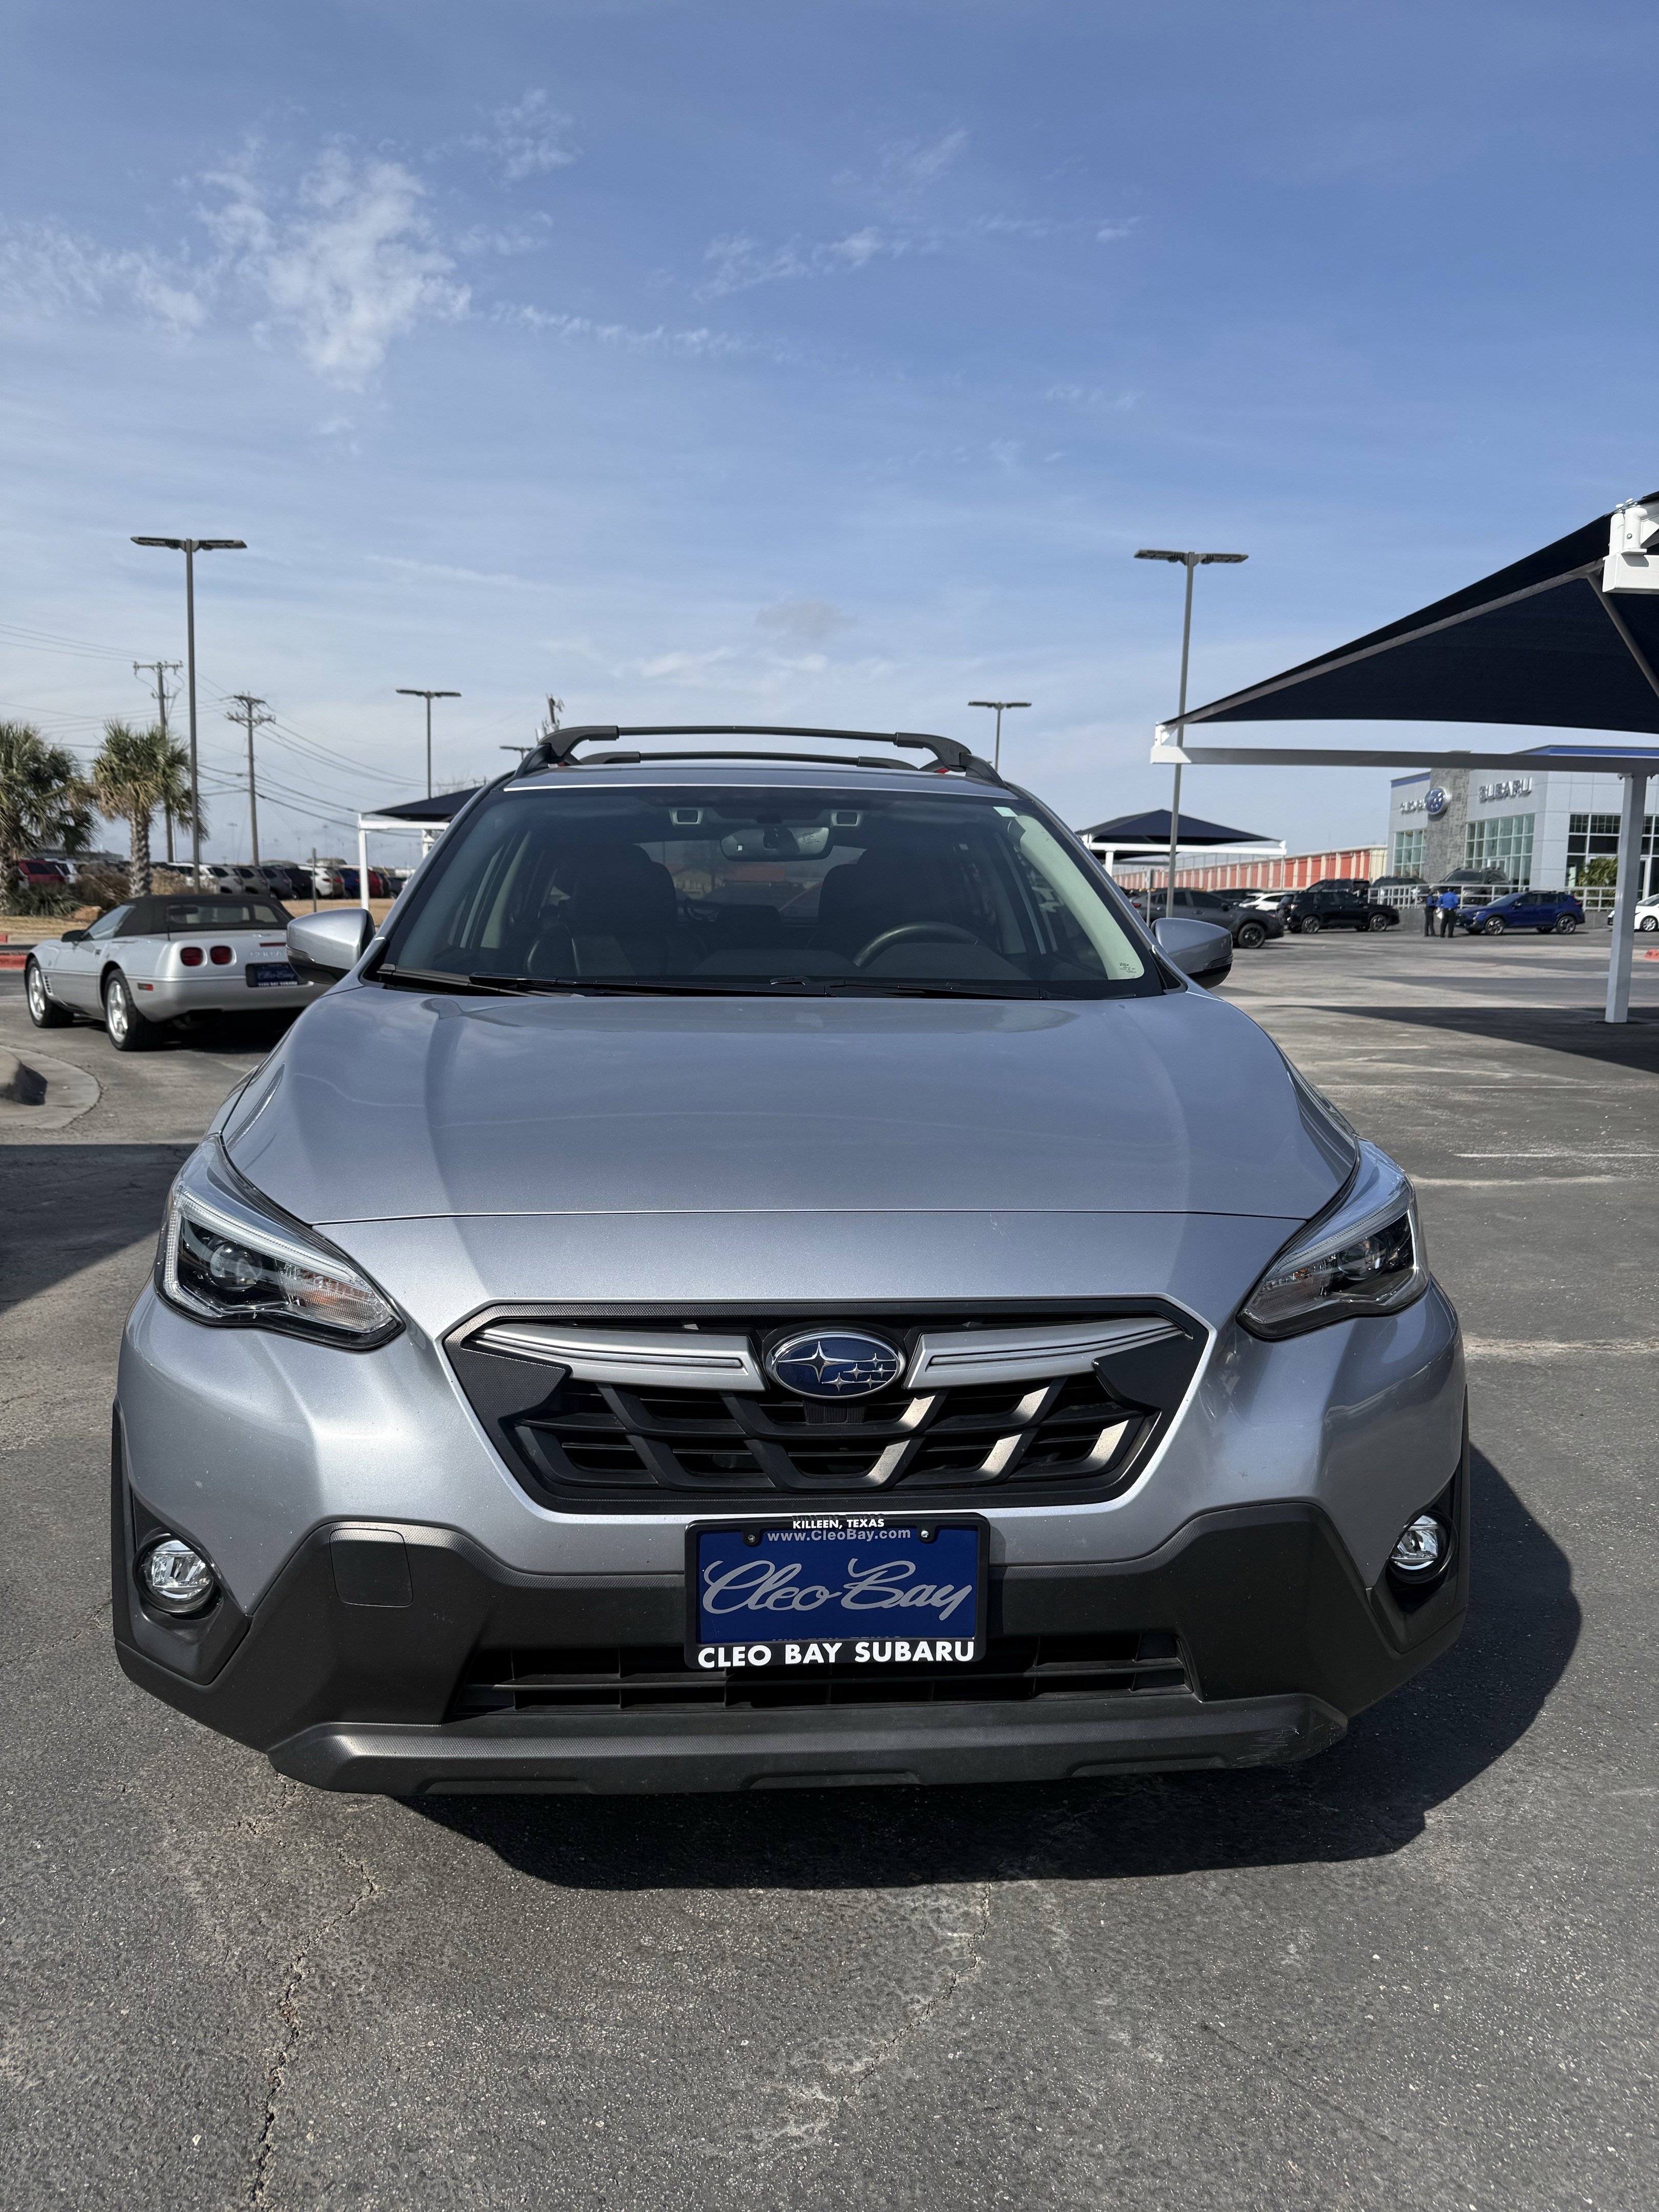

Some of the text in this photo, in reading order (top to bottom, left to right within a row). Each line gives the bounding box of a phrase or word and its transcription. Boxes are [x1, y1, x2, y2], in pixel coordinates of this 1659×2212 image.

[1479, 777, 1532, 801] SUBARU
[767, 1528, 911, 1542] www.CleoBay.com
[793, 1519, 884, 1529] KILLEEN, TEXAS
[703, 1558, 972, 1621] Cleo Bay
[698, 1641, 974, 1668] CLEO BAY SUBARU
